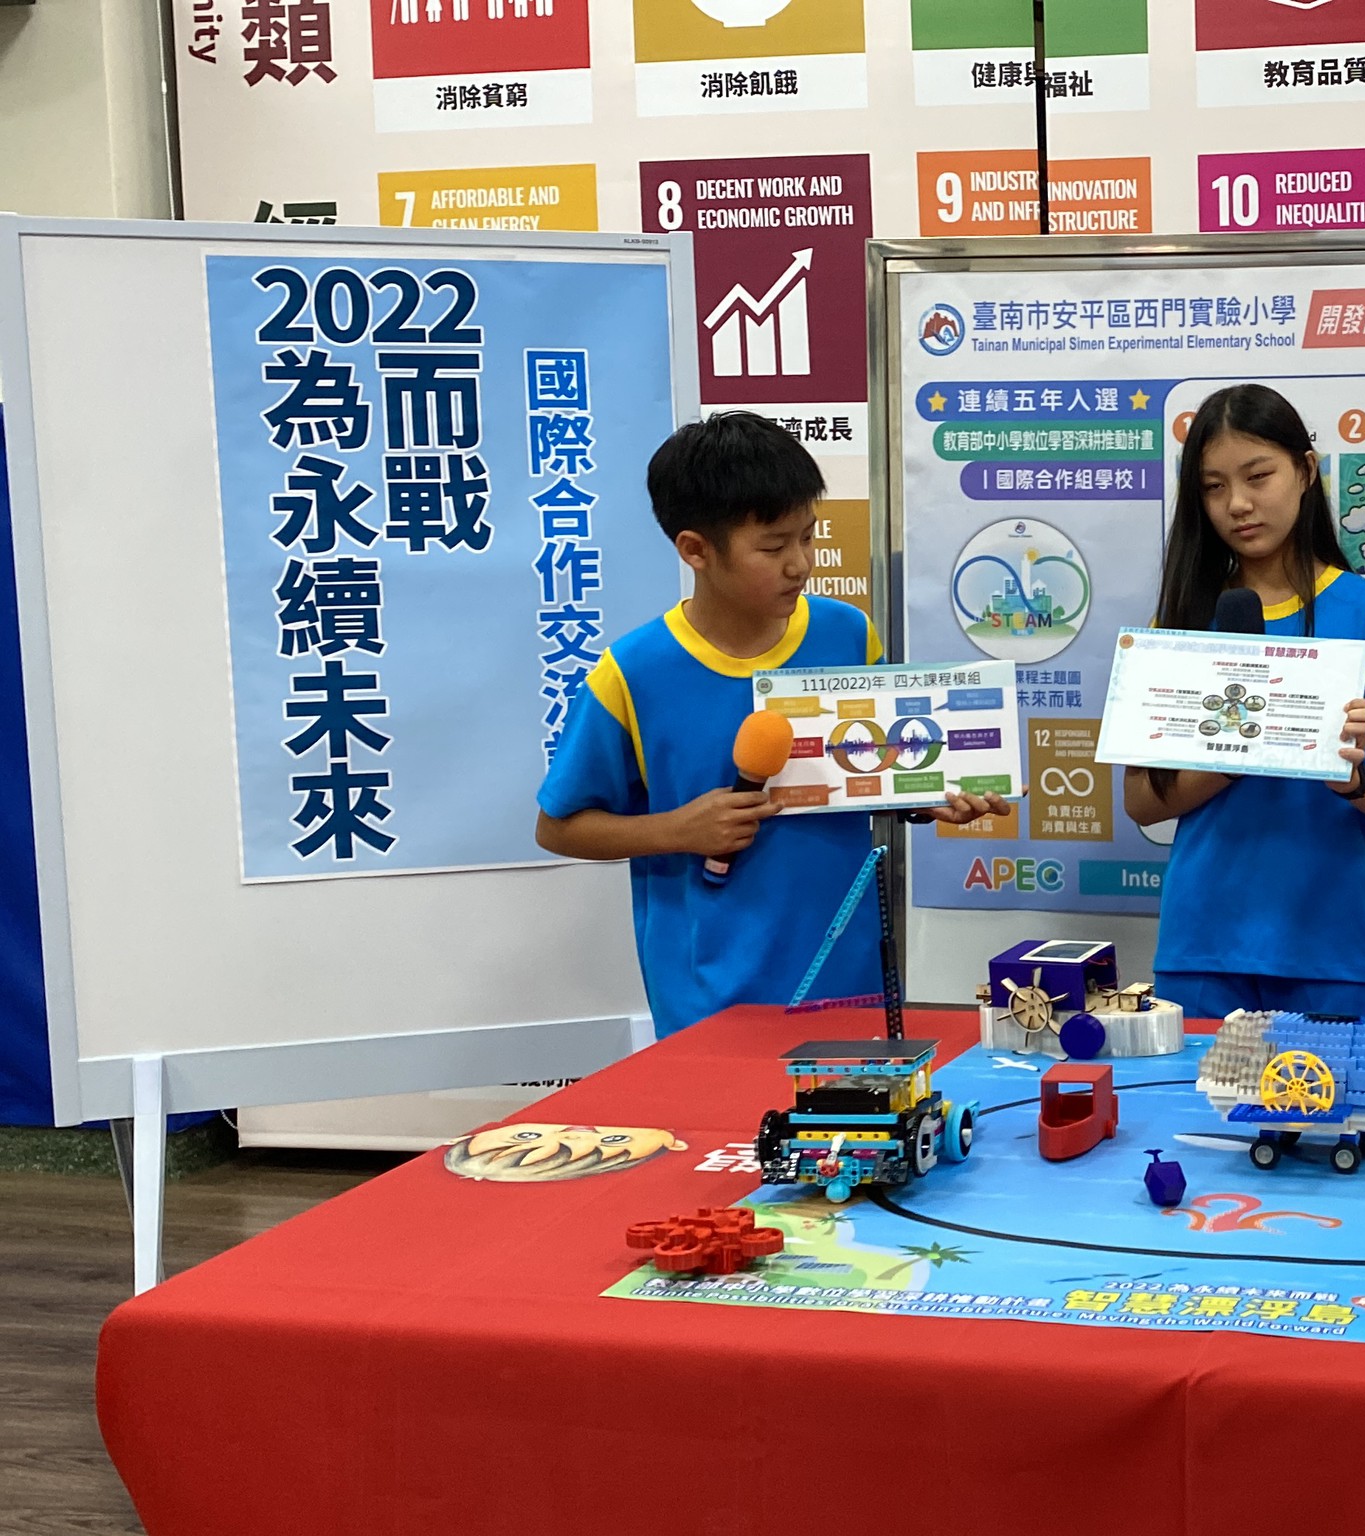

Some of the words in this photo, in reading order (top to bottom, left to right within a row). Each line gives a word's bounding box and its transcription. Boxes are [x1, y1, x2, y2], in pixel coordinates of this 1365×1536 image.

[436, 82, 529, 111] 消除貧窮
[700, 71, 799, 99] 消除飢餓
[696, 178, 753, 200] DECENT
[757, 177, 808, 198] WORK
[811, 175, 842, 196] AND
[1047, 179, 1137, 201] INNOVATION
[1275, 171, 1352, 194] REDUCED
[395, 191, 416, 228] 7
[431, 187, 525, 209] AFFORDABLE
[528, 186, 559, 206] AND
[657, 181, 683, 231] 8
[936, 172, 963, 223] 9
[971, 201, 1004, 221] AND
[1211, 173, 1260, 228] 10
[697, 207, 780, 230] ECONOMIC
[784, 204, 854, 226] GROWTH
[255, 266, 484, 345] 2022
[972, 295, 1297, 331] 臺南市安平區西門實驗小學
[972, 338, 1009, 352] Tainan
[1012, 337, 1066, 355] Municipal
[1069, 337, 1105, 351] Simen
[1108, 335, 1184, 353] Experimental
[1187, 335, 1251, 352] Elementary
[1255, 333, 1296, 348] School
[958, 388, 1119, 413] 連續五年入選
[1348, 413, 1362, 439] 2
[381, 350, 494, 553] 而戰
[996, 469, 1134, 489] 國際合作組學校
[263, 348, 397, 860] 為永續未來
[1034, 729, 1051, 747] 12
[964, 857, 1065, 892] APEC
[1062, 1289, 1359, 1326] 智慧漂浮島
